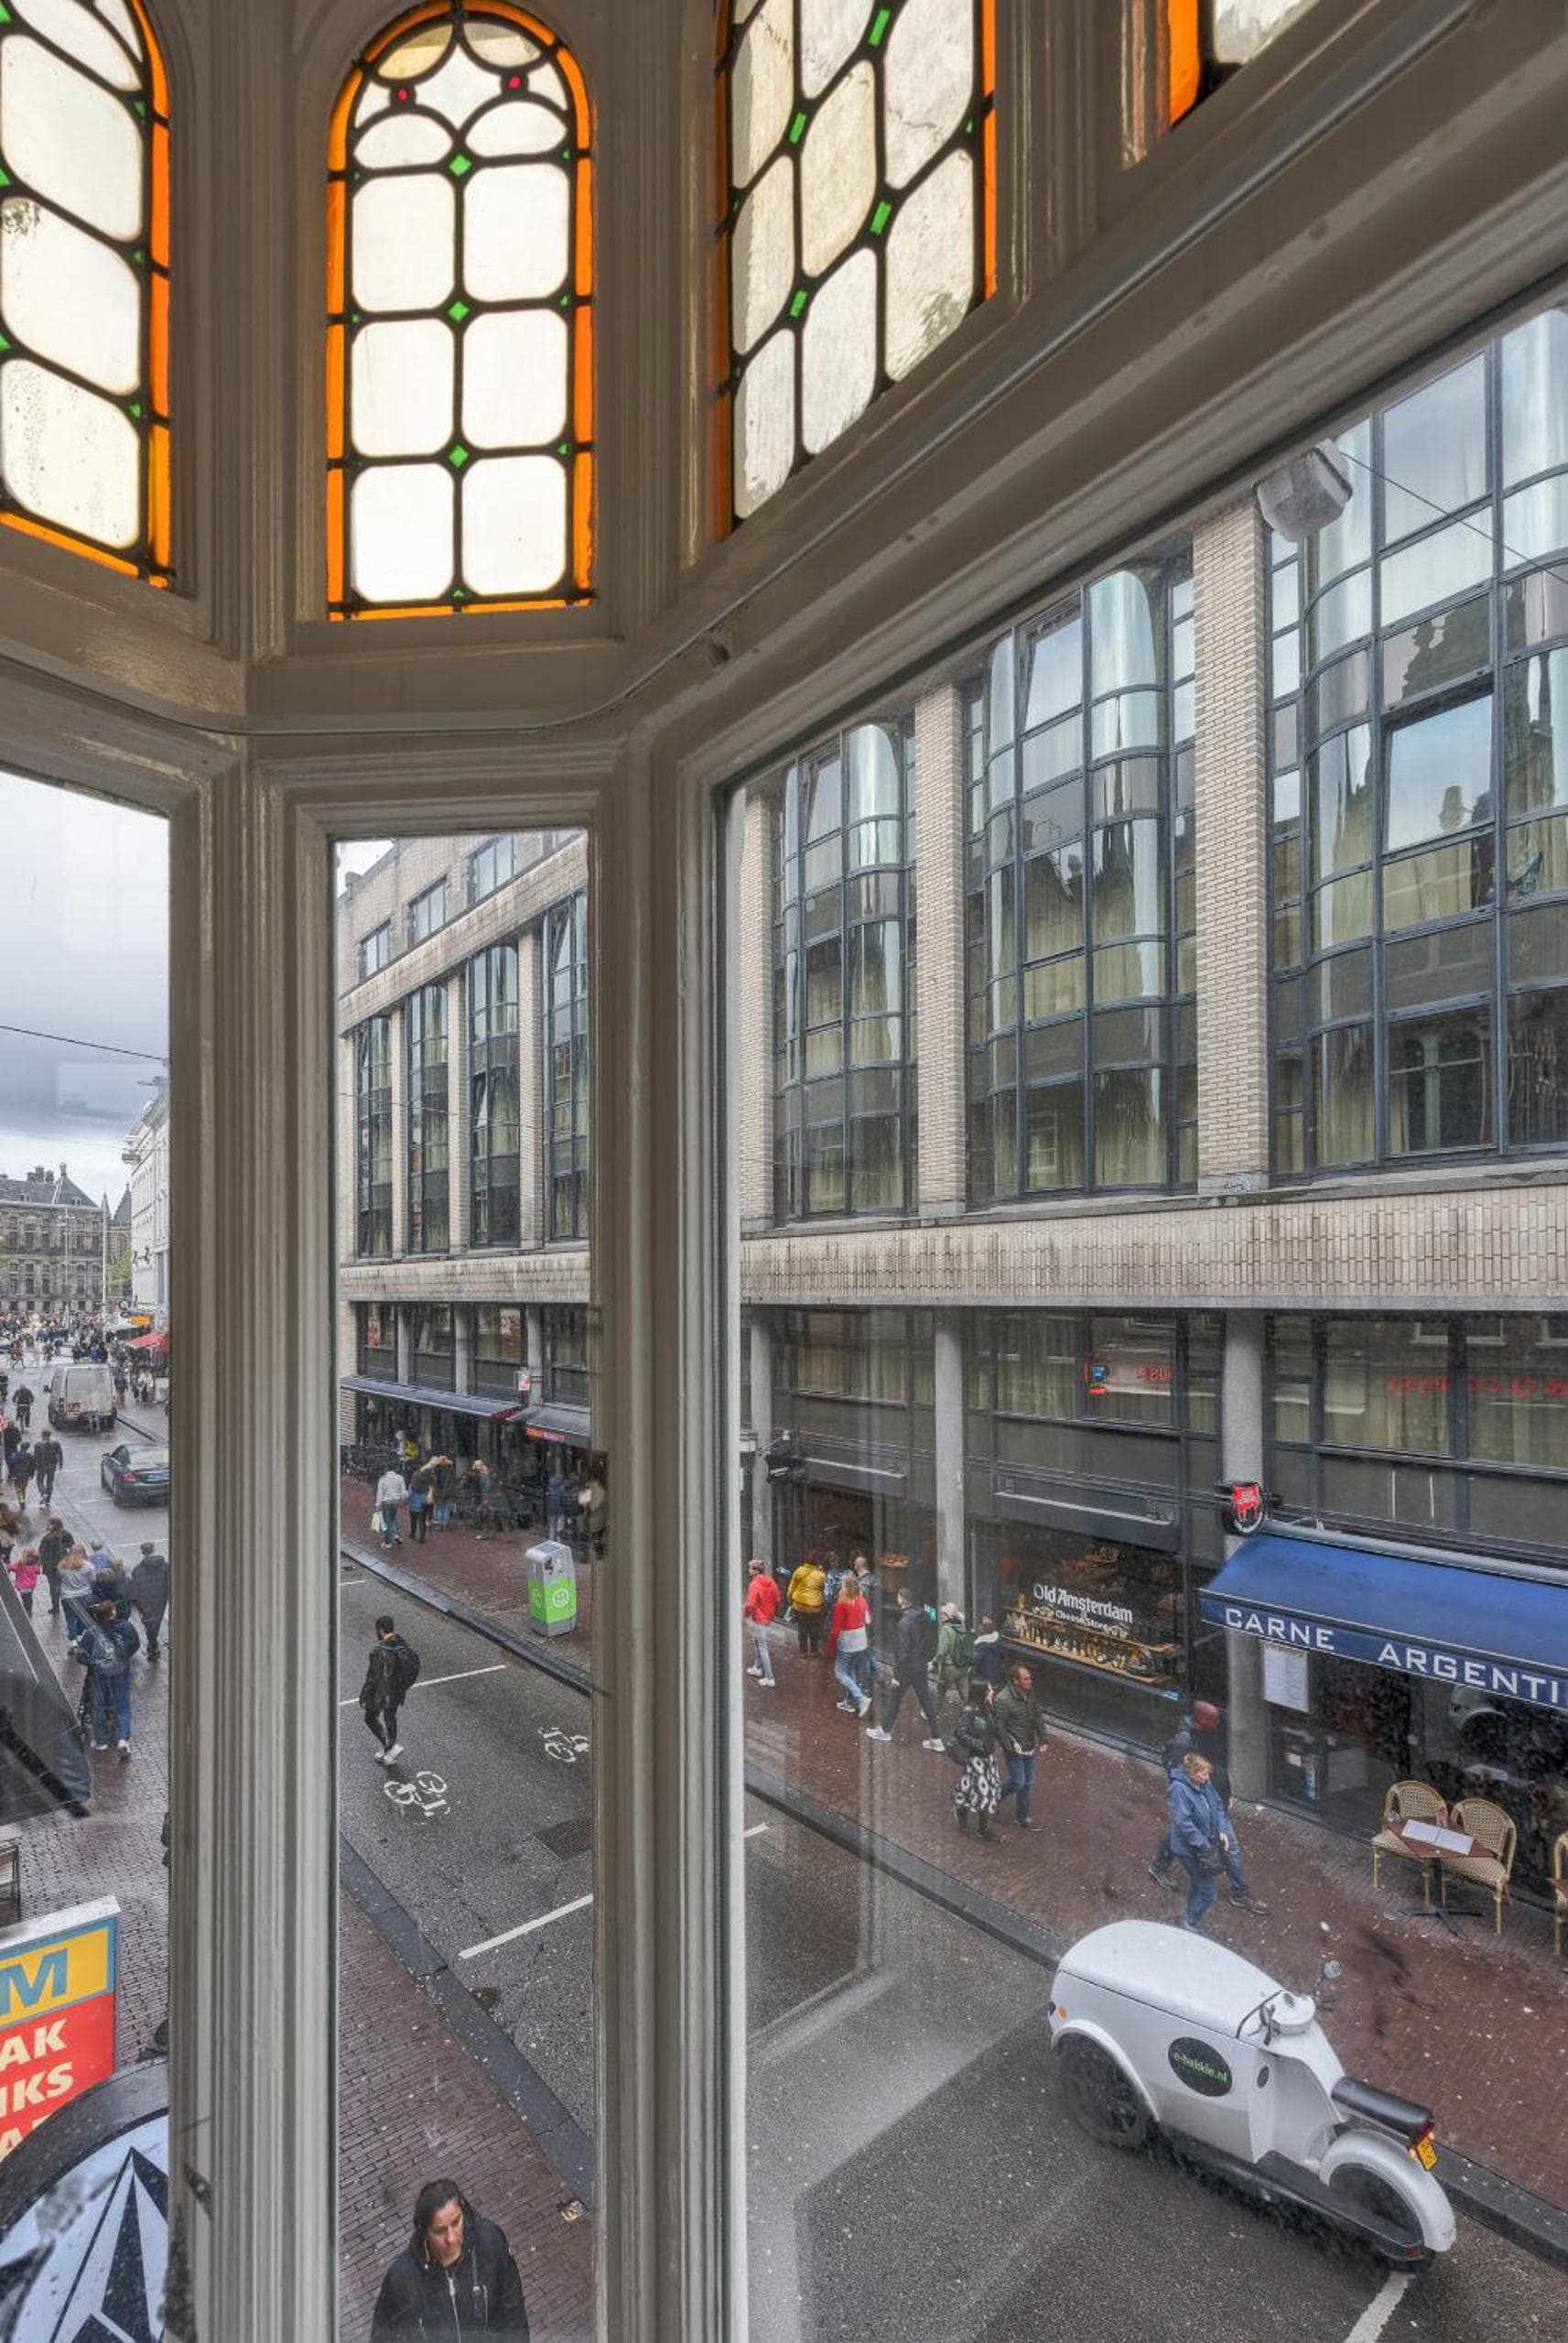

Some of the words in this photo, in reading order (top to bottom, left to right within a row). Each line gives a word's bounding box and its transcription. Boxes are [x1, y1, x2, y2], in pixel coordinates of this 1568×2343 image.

[1033, 1583, 1056, 1603] Old
[1057, 1588, 1133, 1623] Amsterdam
[1226, 1608, 1335, 1650] CARNE
[1378, 1643, 1558, 1704] ARGENTI
